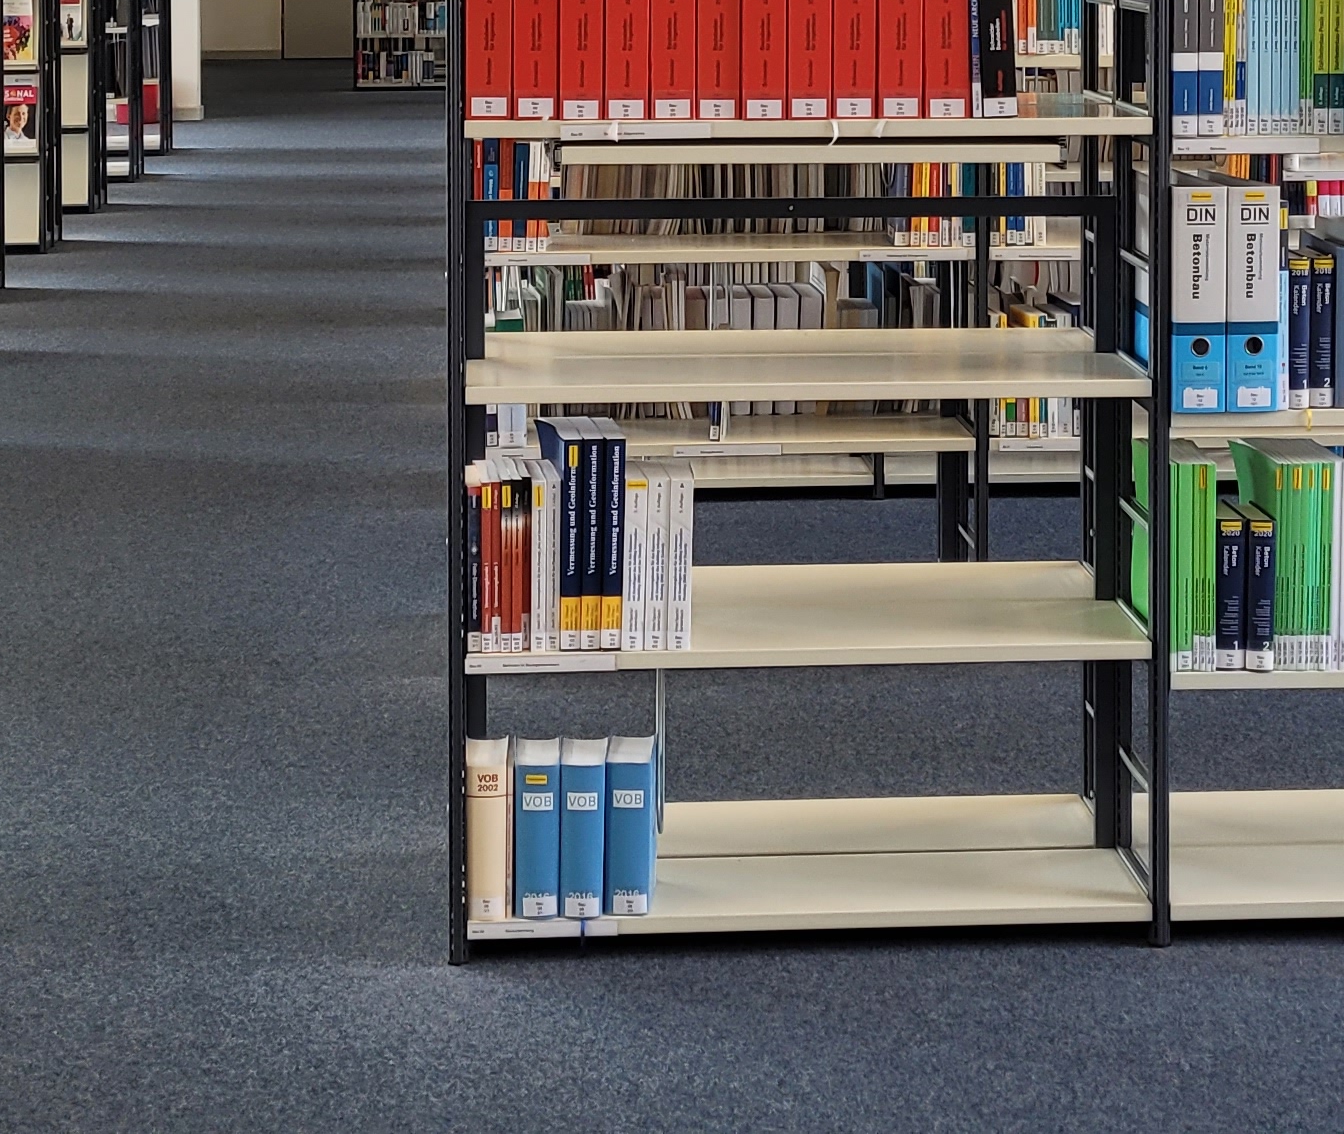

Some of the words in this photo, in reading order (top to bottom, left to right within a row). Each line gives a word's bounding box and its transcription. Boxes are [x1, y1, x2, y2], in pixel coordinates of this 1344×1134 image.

[1187, 208, 1216, 221] DIN
[1241, 207, 1269, 221] DIN
[1192, 234, 1202, 299] Betonbau
[1246, 233, 1256, 299] Betonbau
[1302, 380, 1307, 389] 1
[1324, 378, 1331, 387] 2
[589, 445, 597, 508] Geoinformation
[611, 446, 620, 509] Geoinformation
[567, 528, 576, 576] Vermessung
[588, 527, 597, 575] Vermessung
[609, 527, 619, 576] Vermessung
[1233, 641, 1239, 650] 1
[1263, 642, 1270, 651] 2
[478, 774, 498, 783] VOB
[477, 784, 498, 792] 2002
[524, 796, 551, 807] VOB
[568, 796, 596, 807] VOB
[615, 793, 642, 804] VOB
